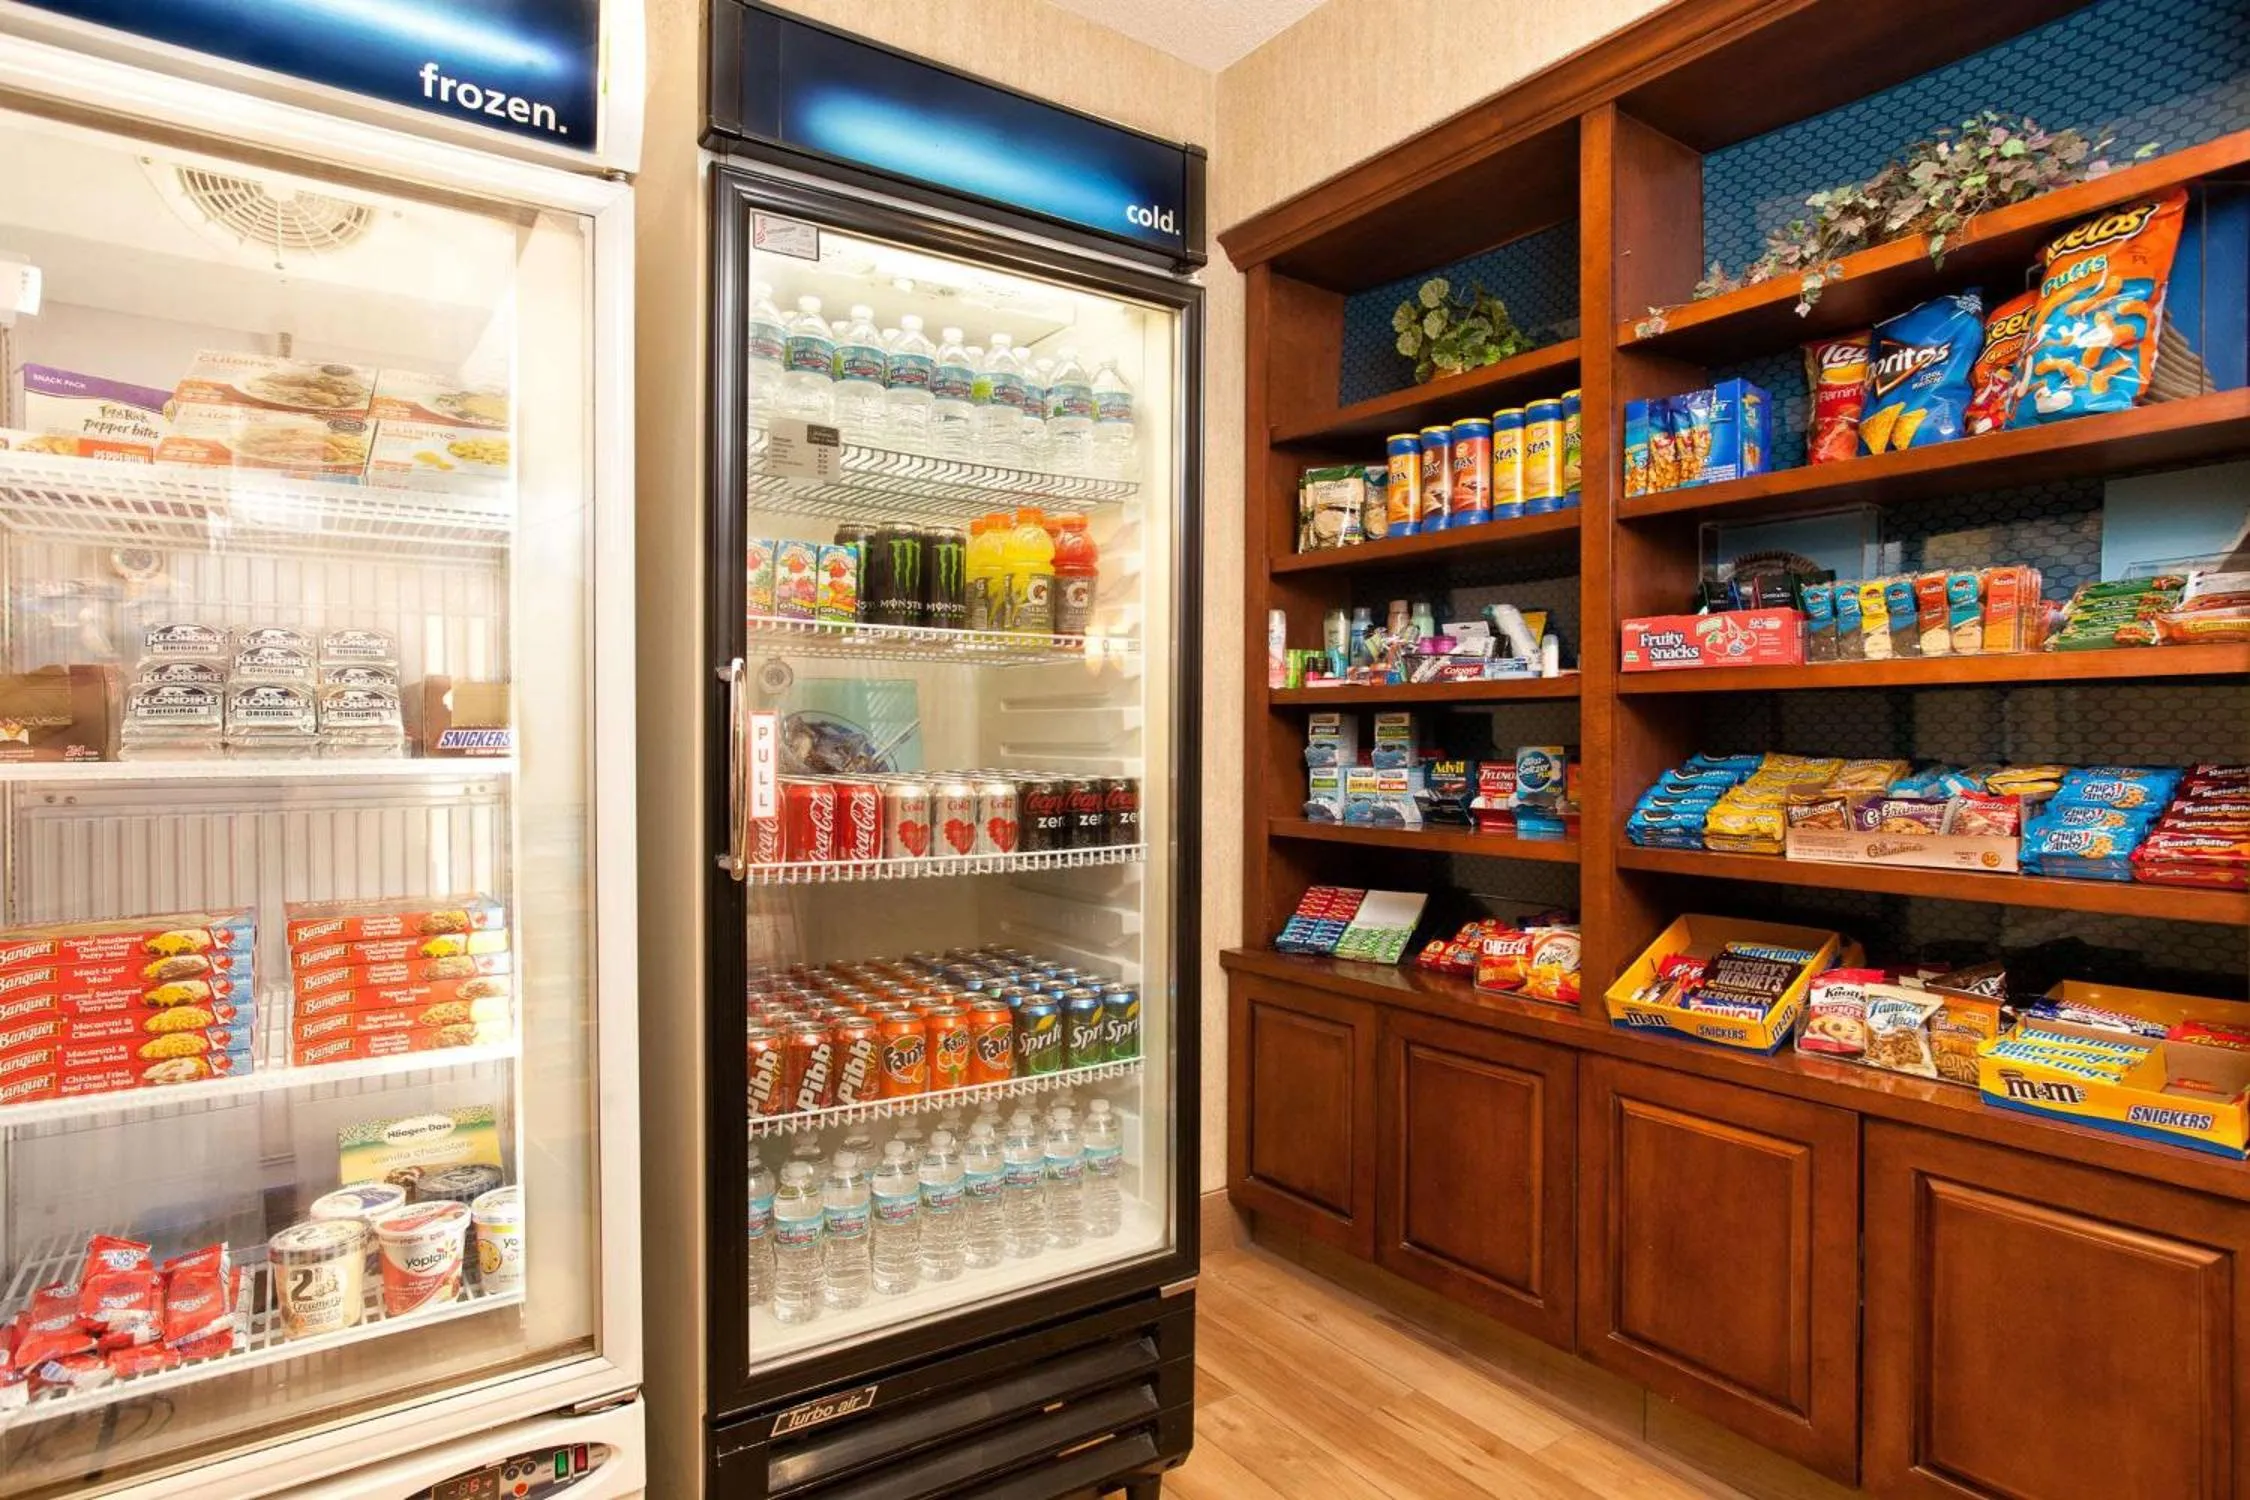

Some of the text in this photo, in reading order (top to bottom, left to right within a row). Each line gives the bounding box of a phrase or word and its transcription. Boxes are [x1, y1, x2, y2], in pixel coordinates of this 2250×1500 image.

[420, 63, 569, 133] frozen.
[1127, 203, 1181, 235] cold.
[2042, 254, 2107, 299] Puffs
[33, 373, 86, 390] SNACK PACK
[84, 419, 159, 439] pepper bites
[1027, 578, 1049, 606] G
[1065, 581, 1089, 608] G
[1640, 632, 1684, 648] Fruity
[1651, 646, 1699, 659] Snacks
[129, 695, 218, 712] KLONDIKE
[147, 706, 199, 715] ORIGINAL
[230, 697, 311, 713] KLONDIKE
[320, 698, 397, 714] KLONDIKE
[441, 731, 512, 746] SNICKERS
[758, 726, 769, 807] PULL
[1432, 760, 1465, 774] Advil
[2184, 804, 2220, 815] Nutter
[1037, 815, 1064, 829] zer
[2159, 838, 2234, 849] Nutter Butter
[297, 919, 344, 941] Banquet
[300, 945, 347, 965] Banquet
[304, 968, 350, 989] Banquet
[1716, 971, 1785, 993] HERSHEY'S
[305, 991, 351, 1013] Banquet
[1868, 1000, 1924, 1020] Famous
[303, 1015, 349, 1038] Banquet
[1699, 1026, 1746, 1039] SNICKERS
[304, 1039, 351, 1061] Banquet
[2131, 1106, 2212, 1130] SNICKERS
[405, 1251, 449, 1272] Yoplait
[289, 1269, 313, 1302] 2
[787, 1394, 862, 1430] Turbo air
